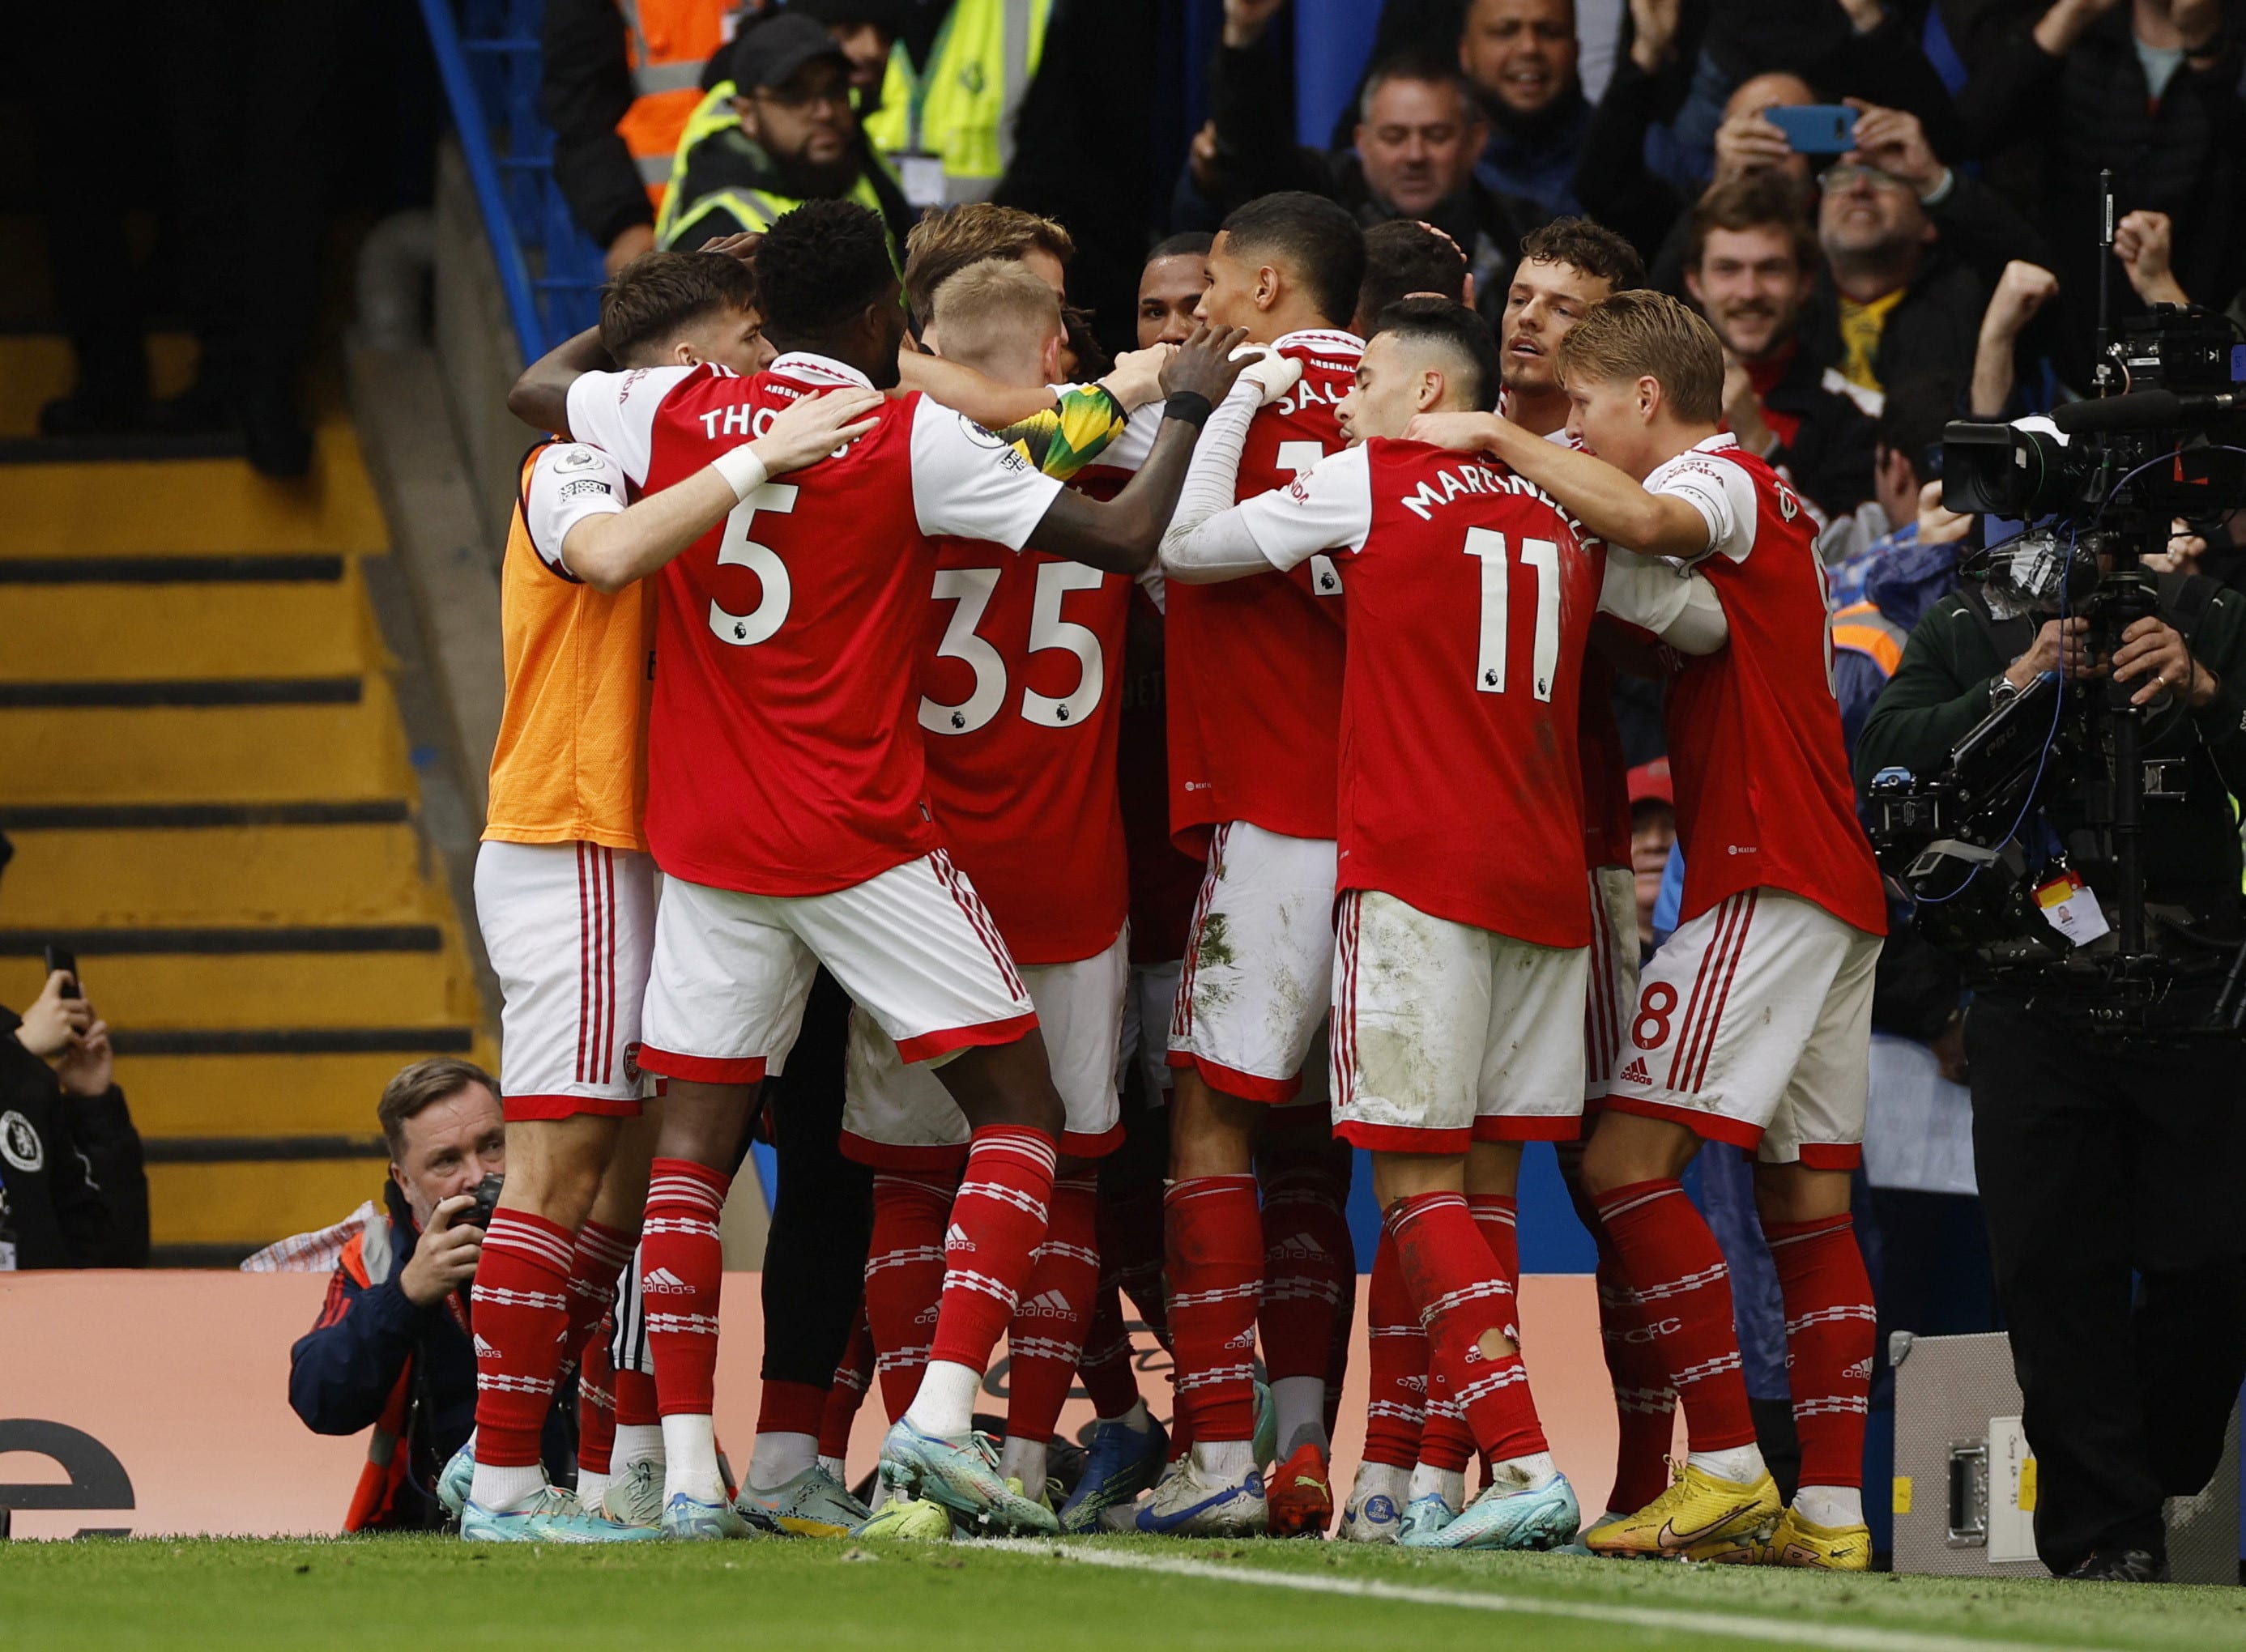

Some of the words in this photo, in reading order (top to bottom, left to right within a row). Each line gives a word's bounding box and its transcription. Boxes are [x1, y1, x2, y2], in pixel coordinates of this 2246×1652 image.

[1310, 358, 1357, 373] ARSENAL
[765, 384, 806, 399] ARSEN
[1276, 379, 1355, 415] SAL
[1659, 466, 1724, 489] WANDA
[709, 483, 792, 646] 5
[1463, 526, 1561, 704] 11
[917, 560, 1105, 735] 35
[1631, 981, 1679, 1051] 8
[1620, 1071, 1653, 1086] adidas
[641, 1280, 697, 1295] adidas
[1013, 1306, 1078, 1322] adidas
